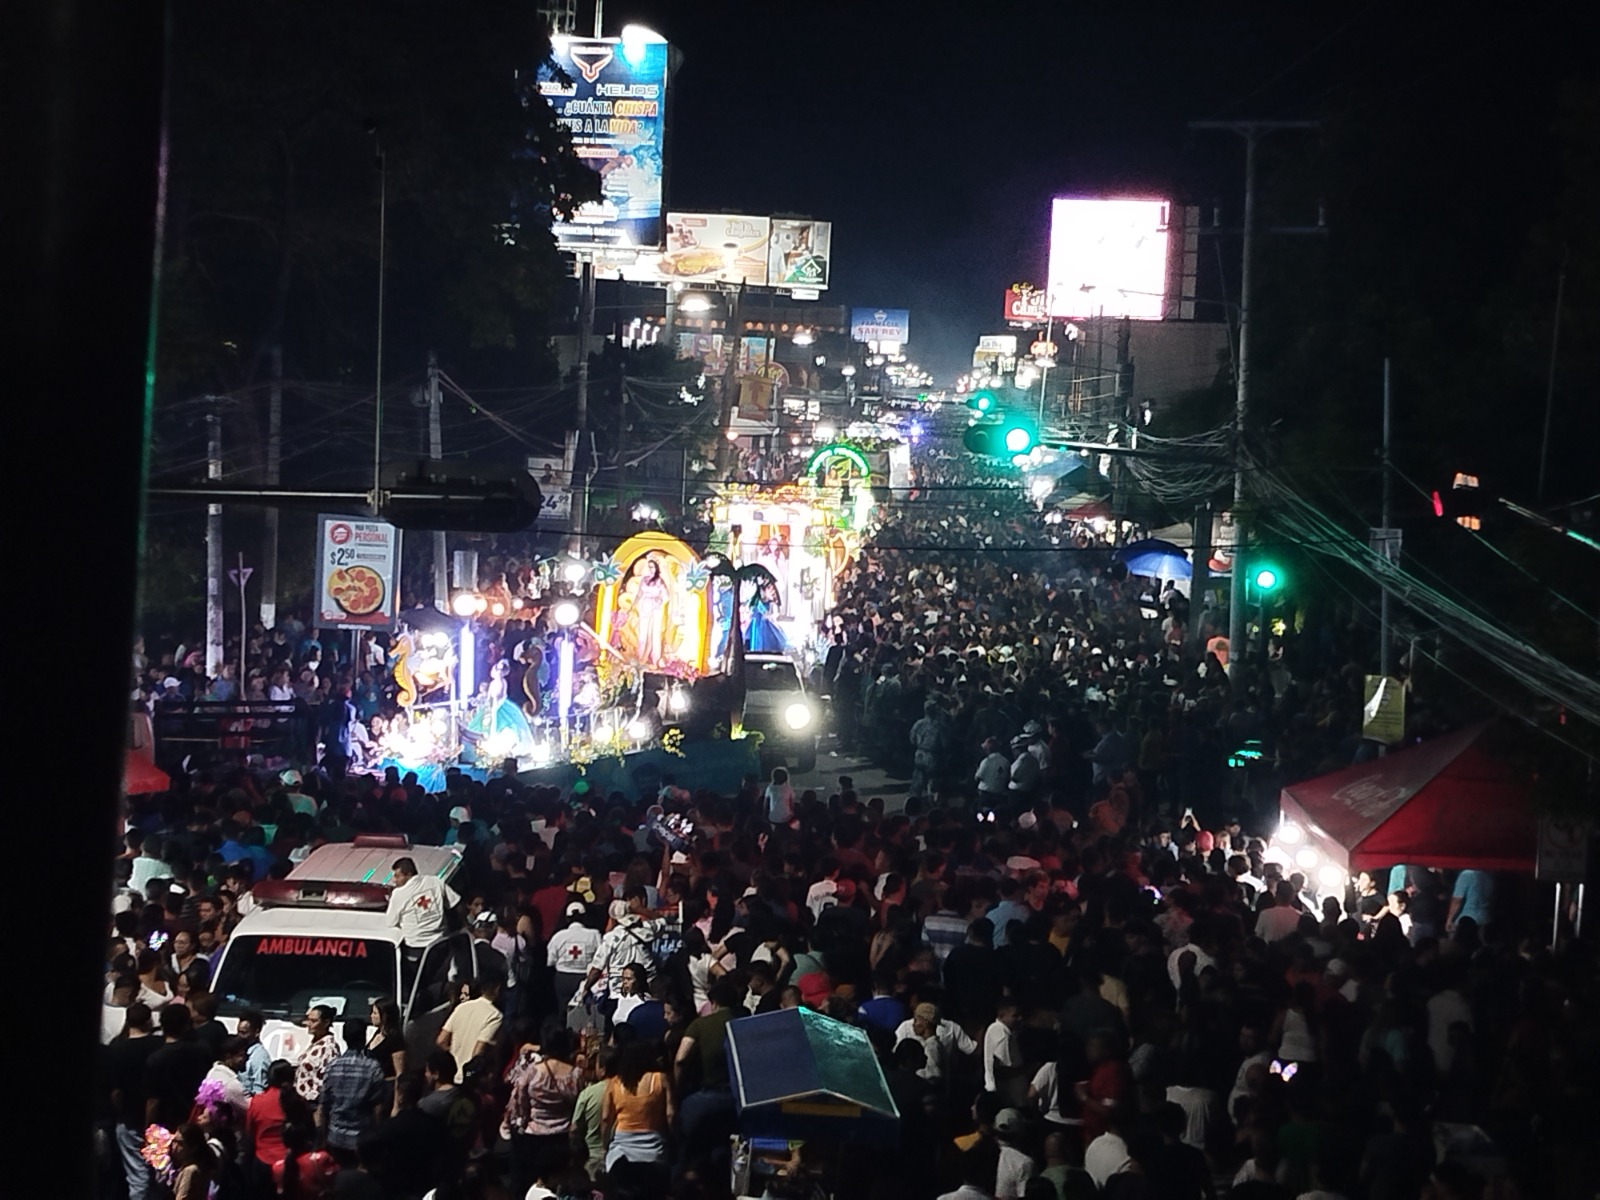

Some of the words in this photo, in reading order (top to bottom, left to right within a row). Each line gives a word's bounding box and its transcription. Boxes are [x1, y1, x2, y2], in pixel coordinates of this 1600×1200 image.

[596, 84, 659, 97] HELIOS
[564, 98, 612, 115] ¿CUÁNTA
[615, 101, 658, 116] CHISPA
[595, 118, 609, 133] LA
[858, 327, 878, 335] SAN
[882, 328, 901, 336] REY
